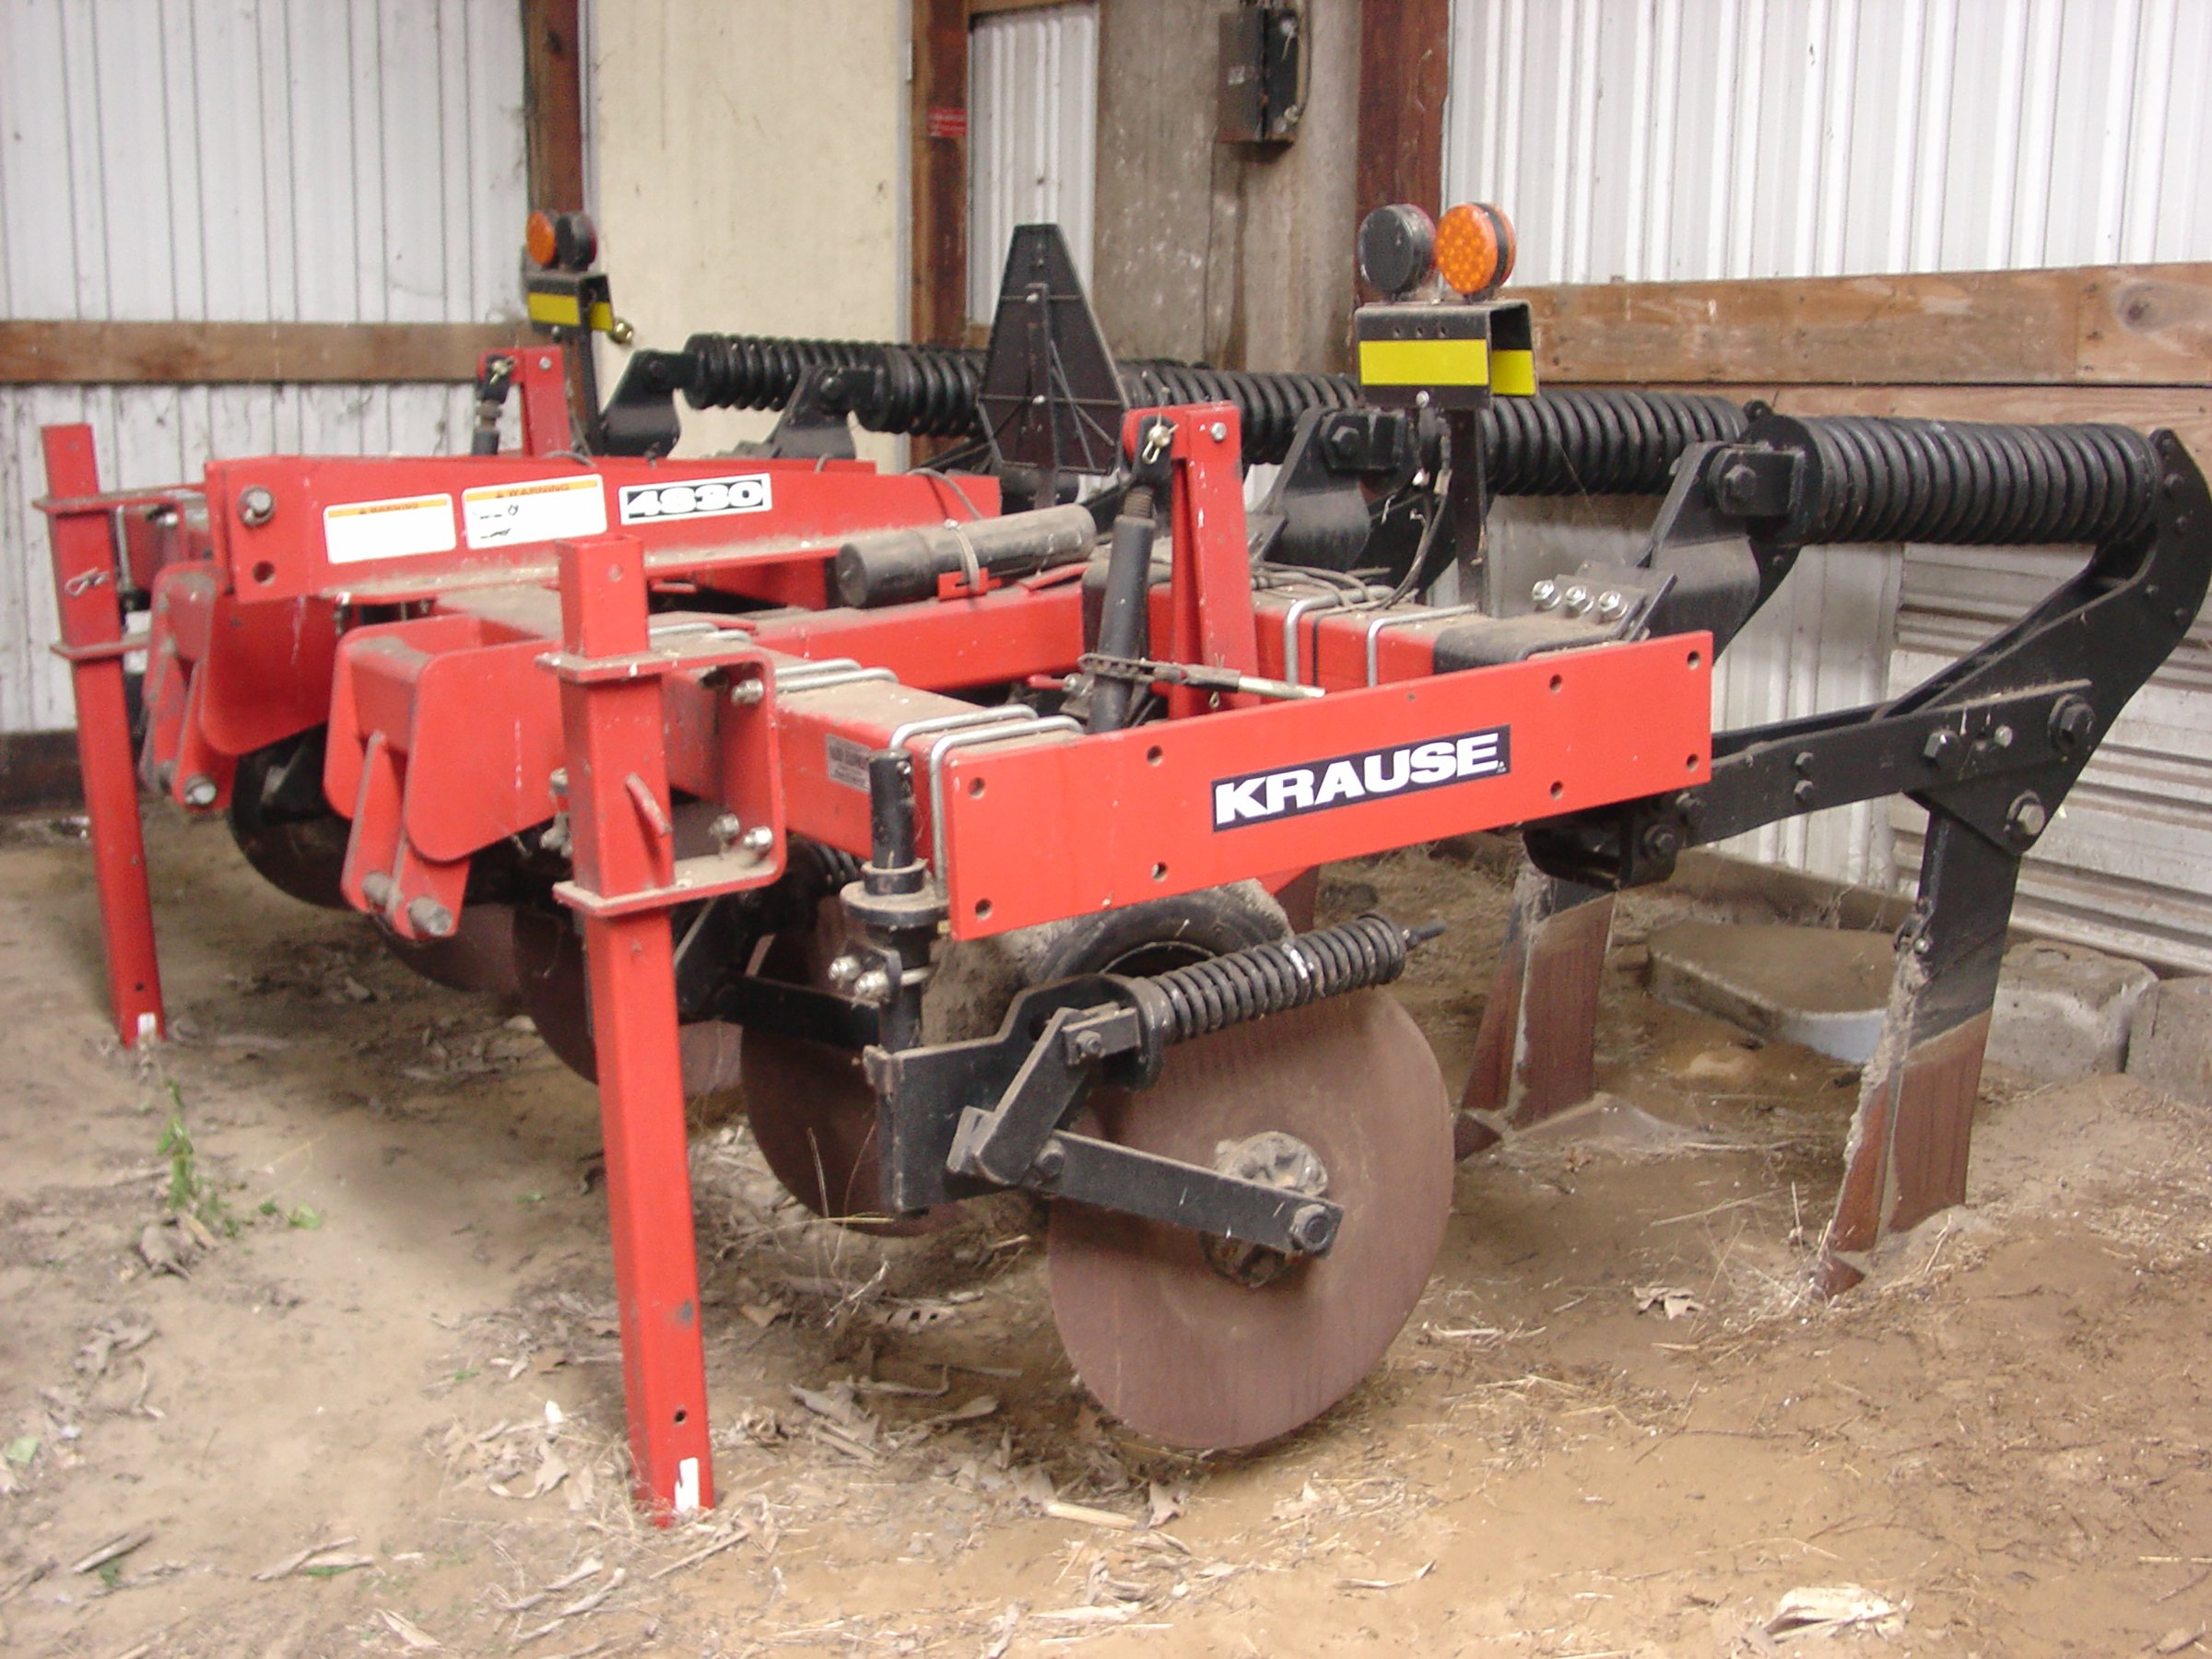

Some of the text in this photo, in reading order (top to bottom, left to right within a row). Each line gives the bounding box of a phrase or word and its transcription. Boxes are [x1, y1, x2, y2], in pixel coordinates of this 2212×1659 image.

[509, 484, 571, 497] WARNING
[627, 480, 763, 516] 4830
[1215, 733, 1499, 825] KRAUSE
